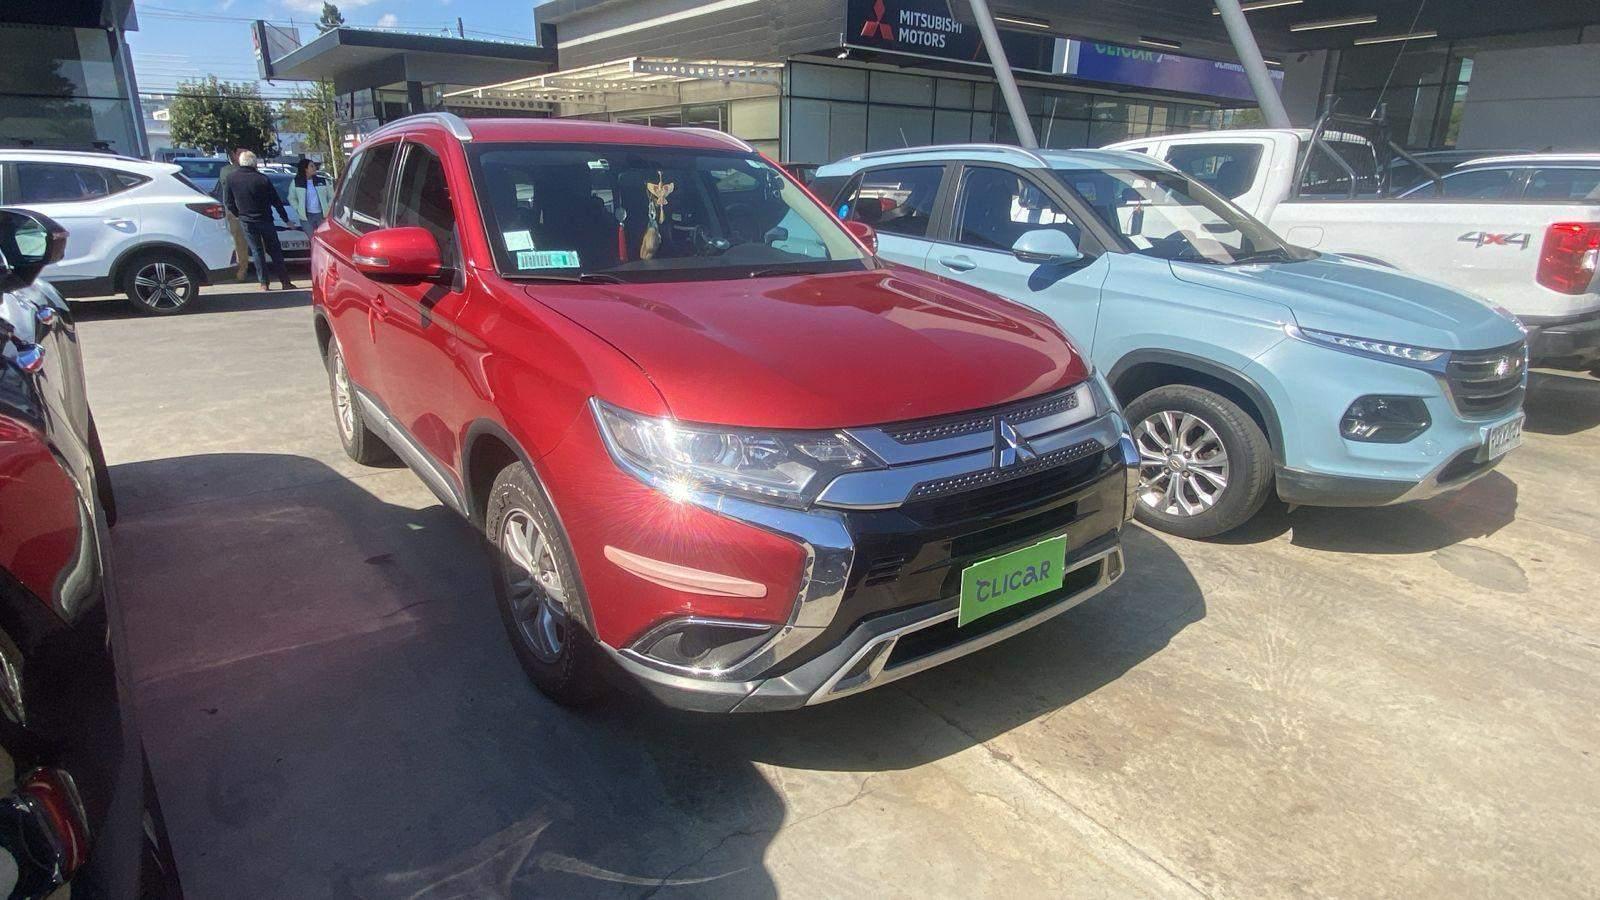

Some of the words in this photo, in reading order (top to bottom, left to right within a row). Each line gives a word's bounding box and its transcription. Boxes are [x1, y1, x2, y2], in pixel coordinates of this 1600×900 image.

[899, 9, 962, 34] MITSUBISHI
[898, 28, 946, 48] MOTORS
[1457, 231, 1531, 251] 4x4
